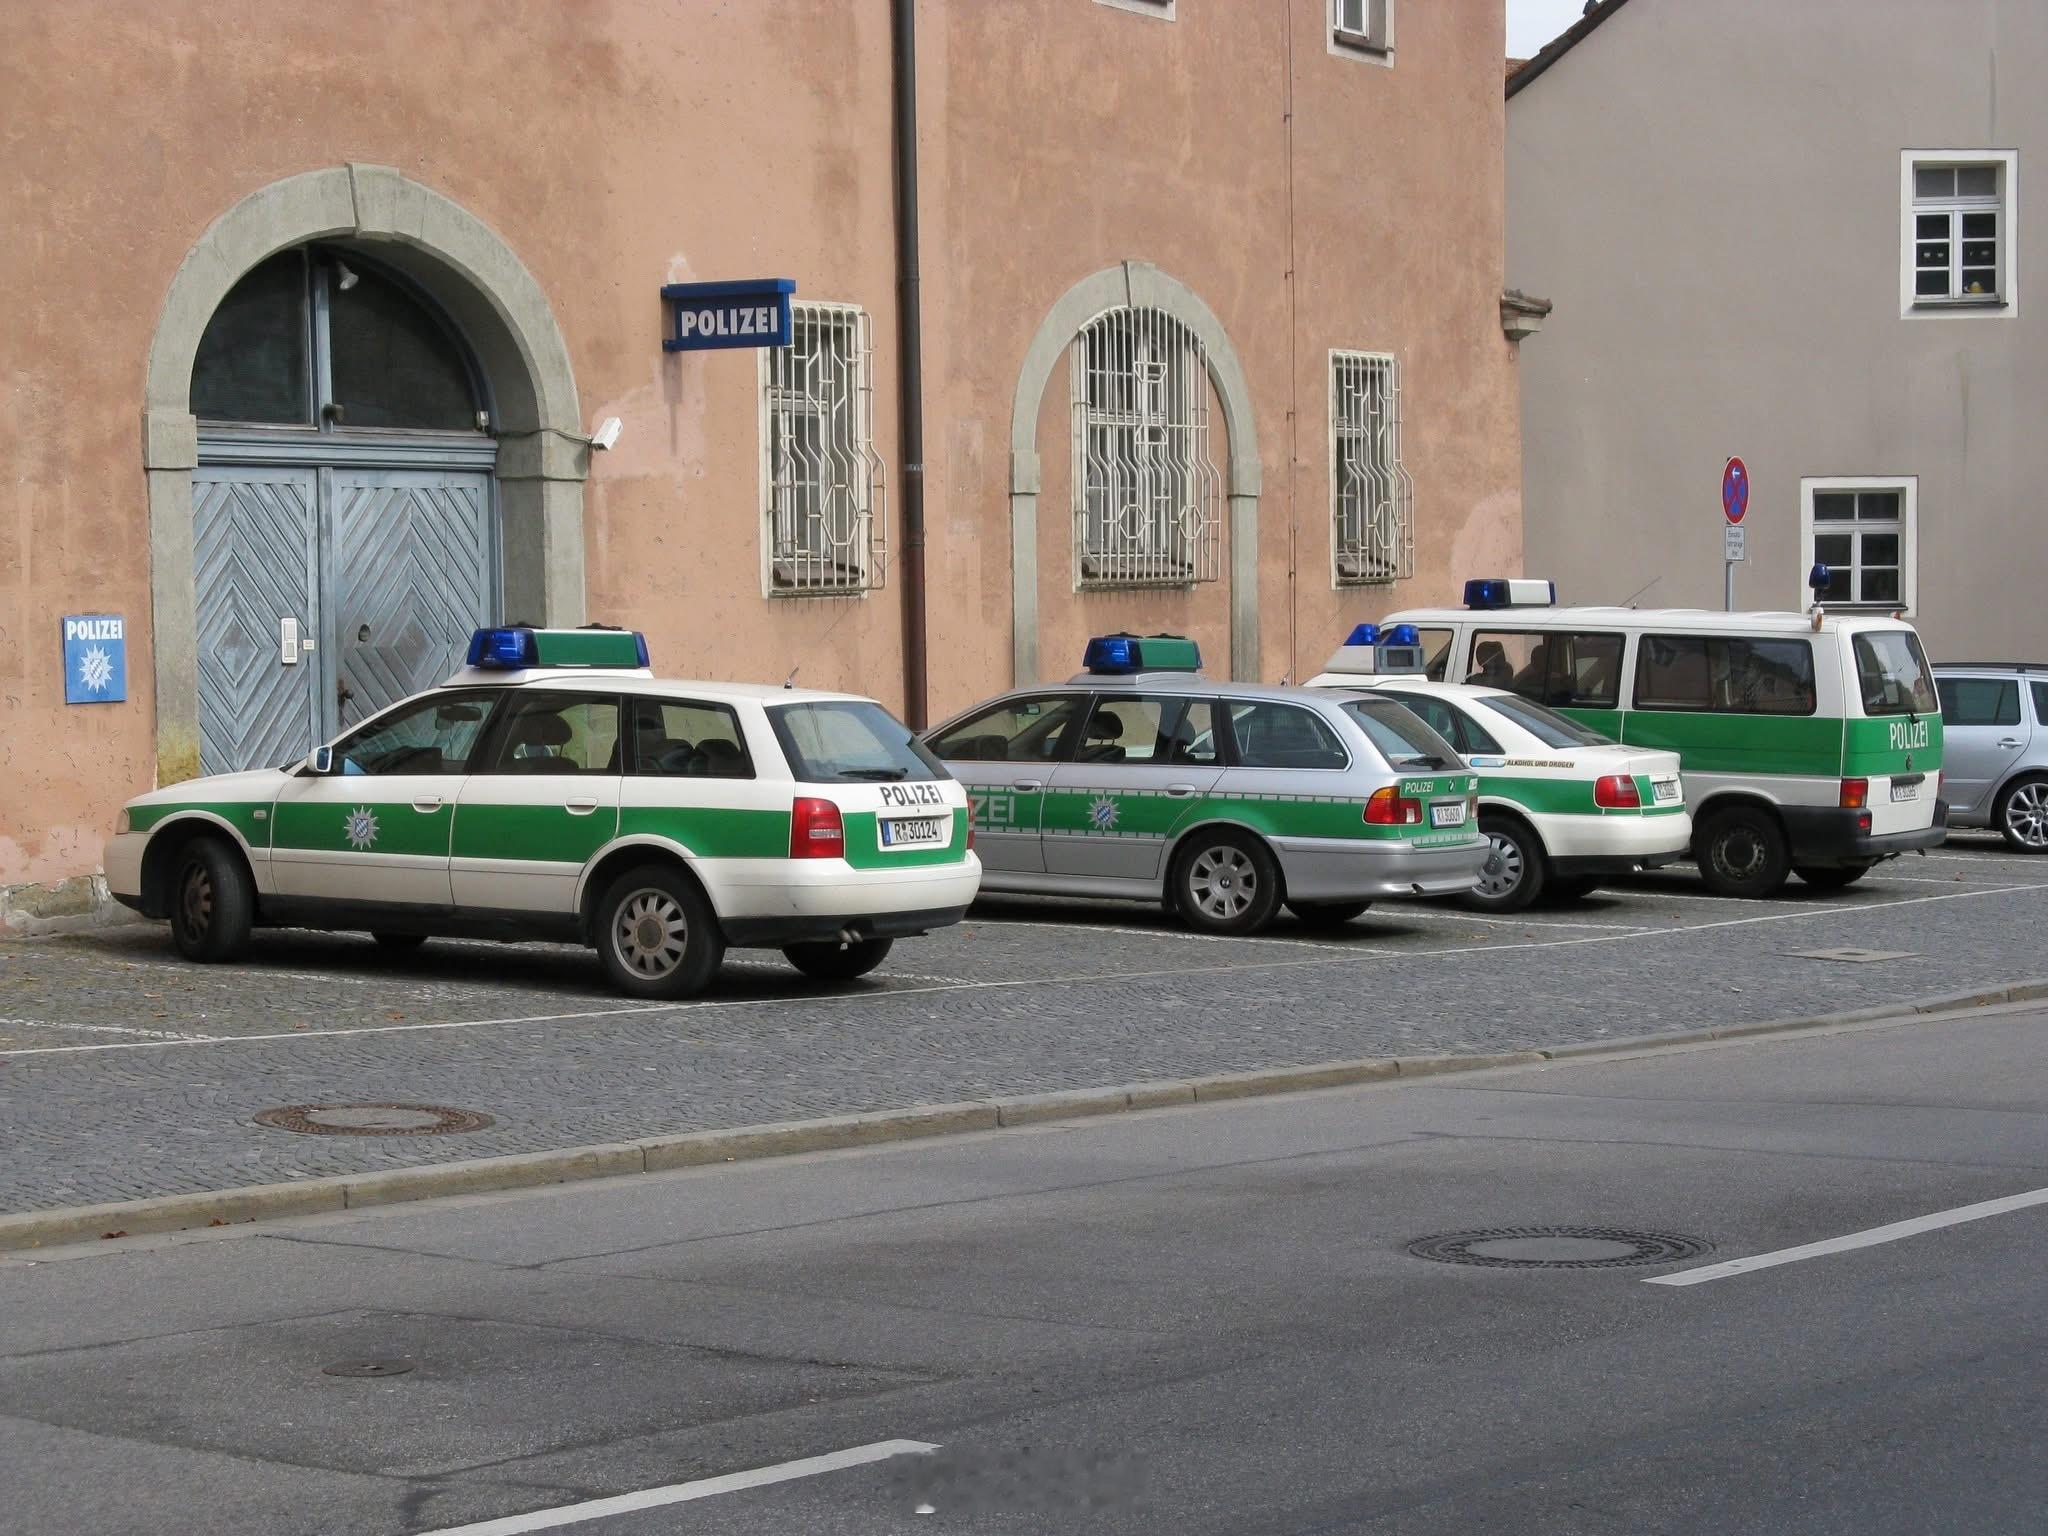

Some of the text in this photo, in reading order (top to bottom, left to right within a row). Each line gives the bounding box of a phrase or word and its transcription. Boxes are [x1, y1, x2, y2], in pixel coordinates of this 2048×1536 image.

[680, 306, 779, 337] POLIZEI
[66, 619, 123, 641] POLIZEI
[1889, 720, 1929, 750] POLIZEI
[879, 784, 944, 806] POLIZEI
[1404, 780, 1434, 794] POLIZEI
[894, 821, 938, 841] R 30124
